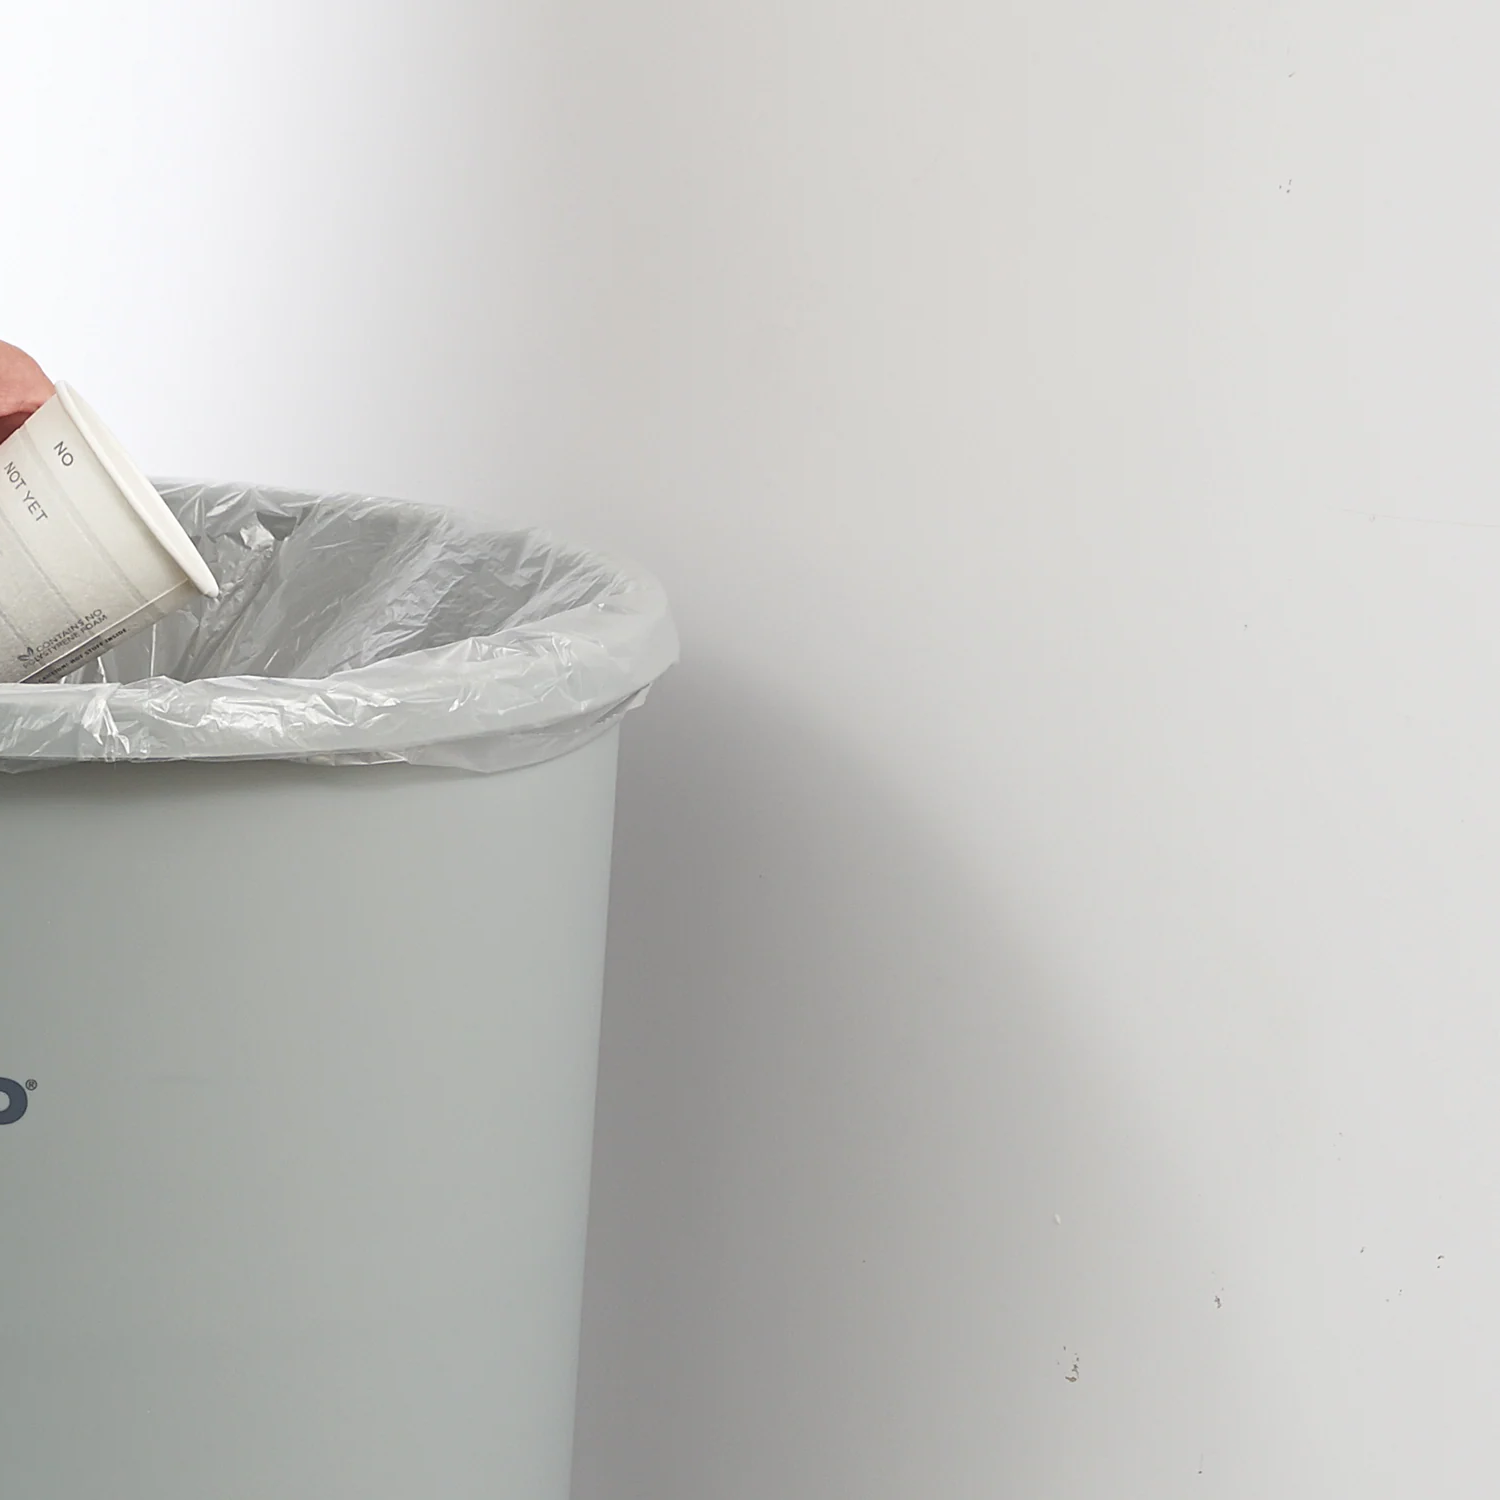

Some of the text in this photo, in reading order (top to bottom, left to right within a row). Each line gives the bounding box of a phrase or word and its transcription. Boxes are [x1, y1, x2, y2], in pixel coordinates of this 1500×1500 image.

[53, 440, 74, 467] NO
[3, 461, 48, 522] NOT YET
[22, 614, 108, 669] POLYSTYRENE FOAM
[36, 608, 102, 653] CONTAINS NO
